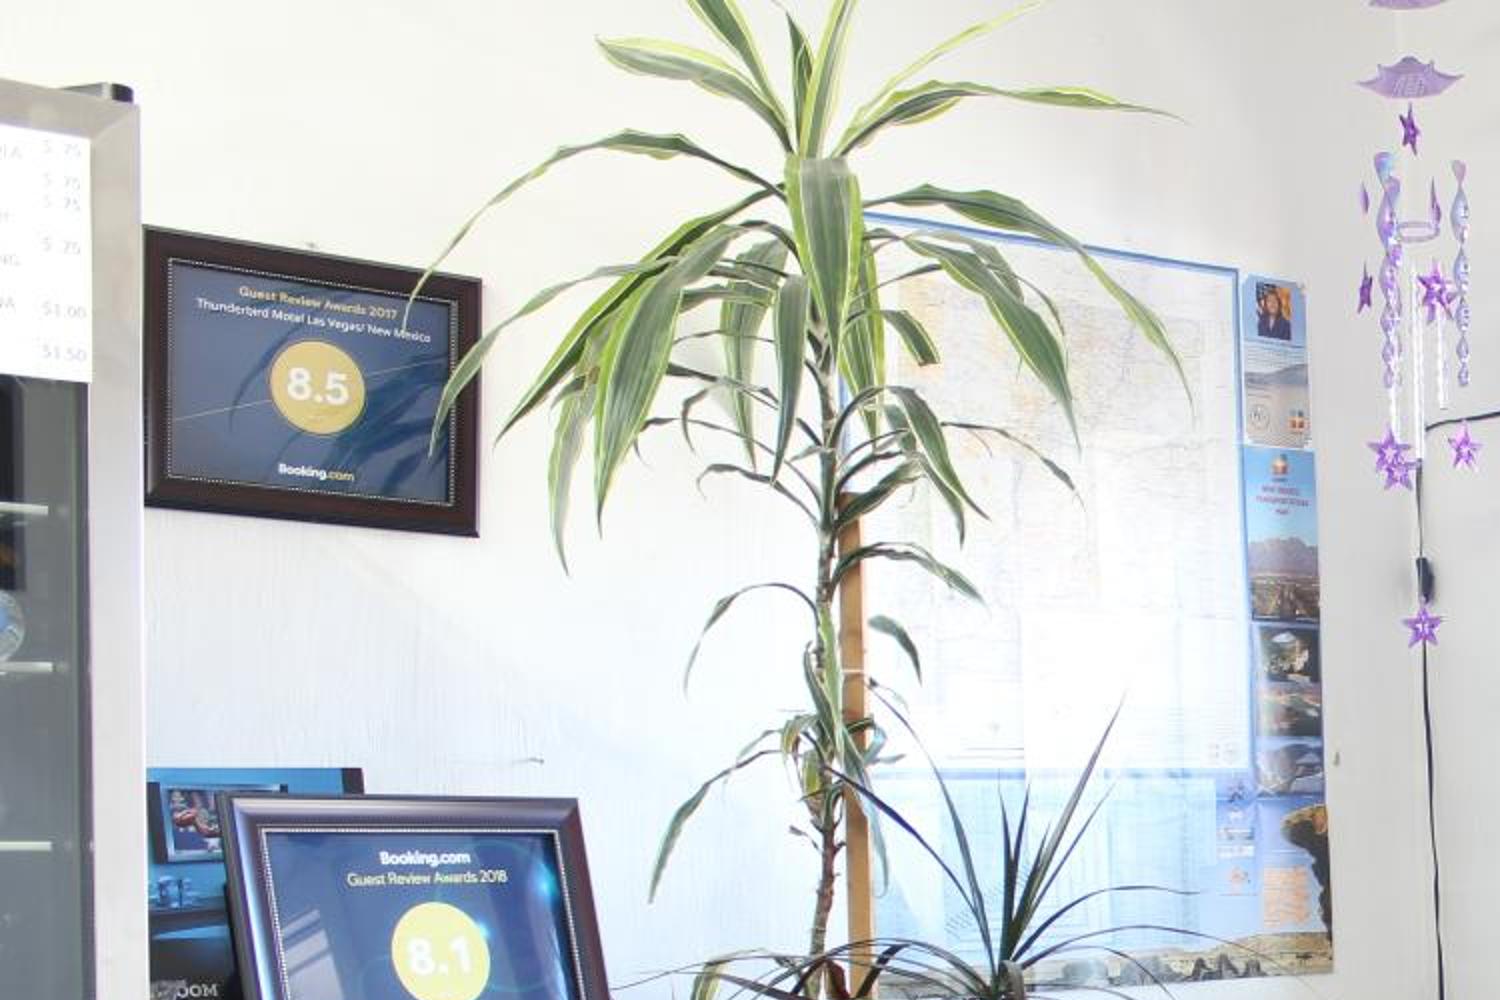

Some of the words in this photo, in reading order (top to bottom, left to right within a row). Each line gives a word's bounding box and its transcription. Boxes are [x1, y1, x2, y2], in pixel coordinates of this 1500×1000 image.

[197, 297, 269, 319] Thunderbird
[271, 308, 304, 323] Motel
[307, 314, 326, 327] Las
[368, 324, 391, 338] New
[394, 328, 431, 343] Mexico
[239, 286, 275, 300] Guest
[279, 291, 321, 308] Review
[324, 301, 366, 316] Awards
[369, 307, 399, 320] 2017
[288, 367, 350, 405] 8.5
[278, 463, 355, 481] Booking.com
[379, 851, 471, 867] Booking.com
[347, 872, 385, 887] Guest
[387, 871, 431, 885] Review
[434, 871, 478, 884] Awards
[479, 869, 508, 883] 2018
[406, 935, 473, 976] 8.1
